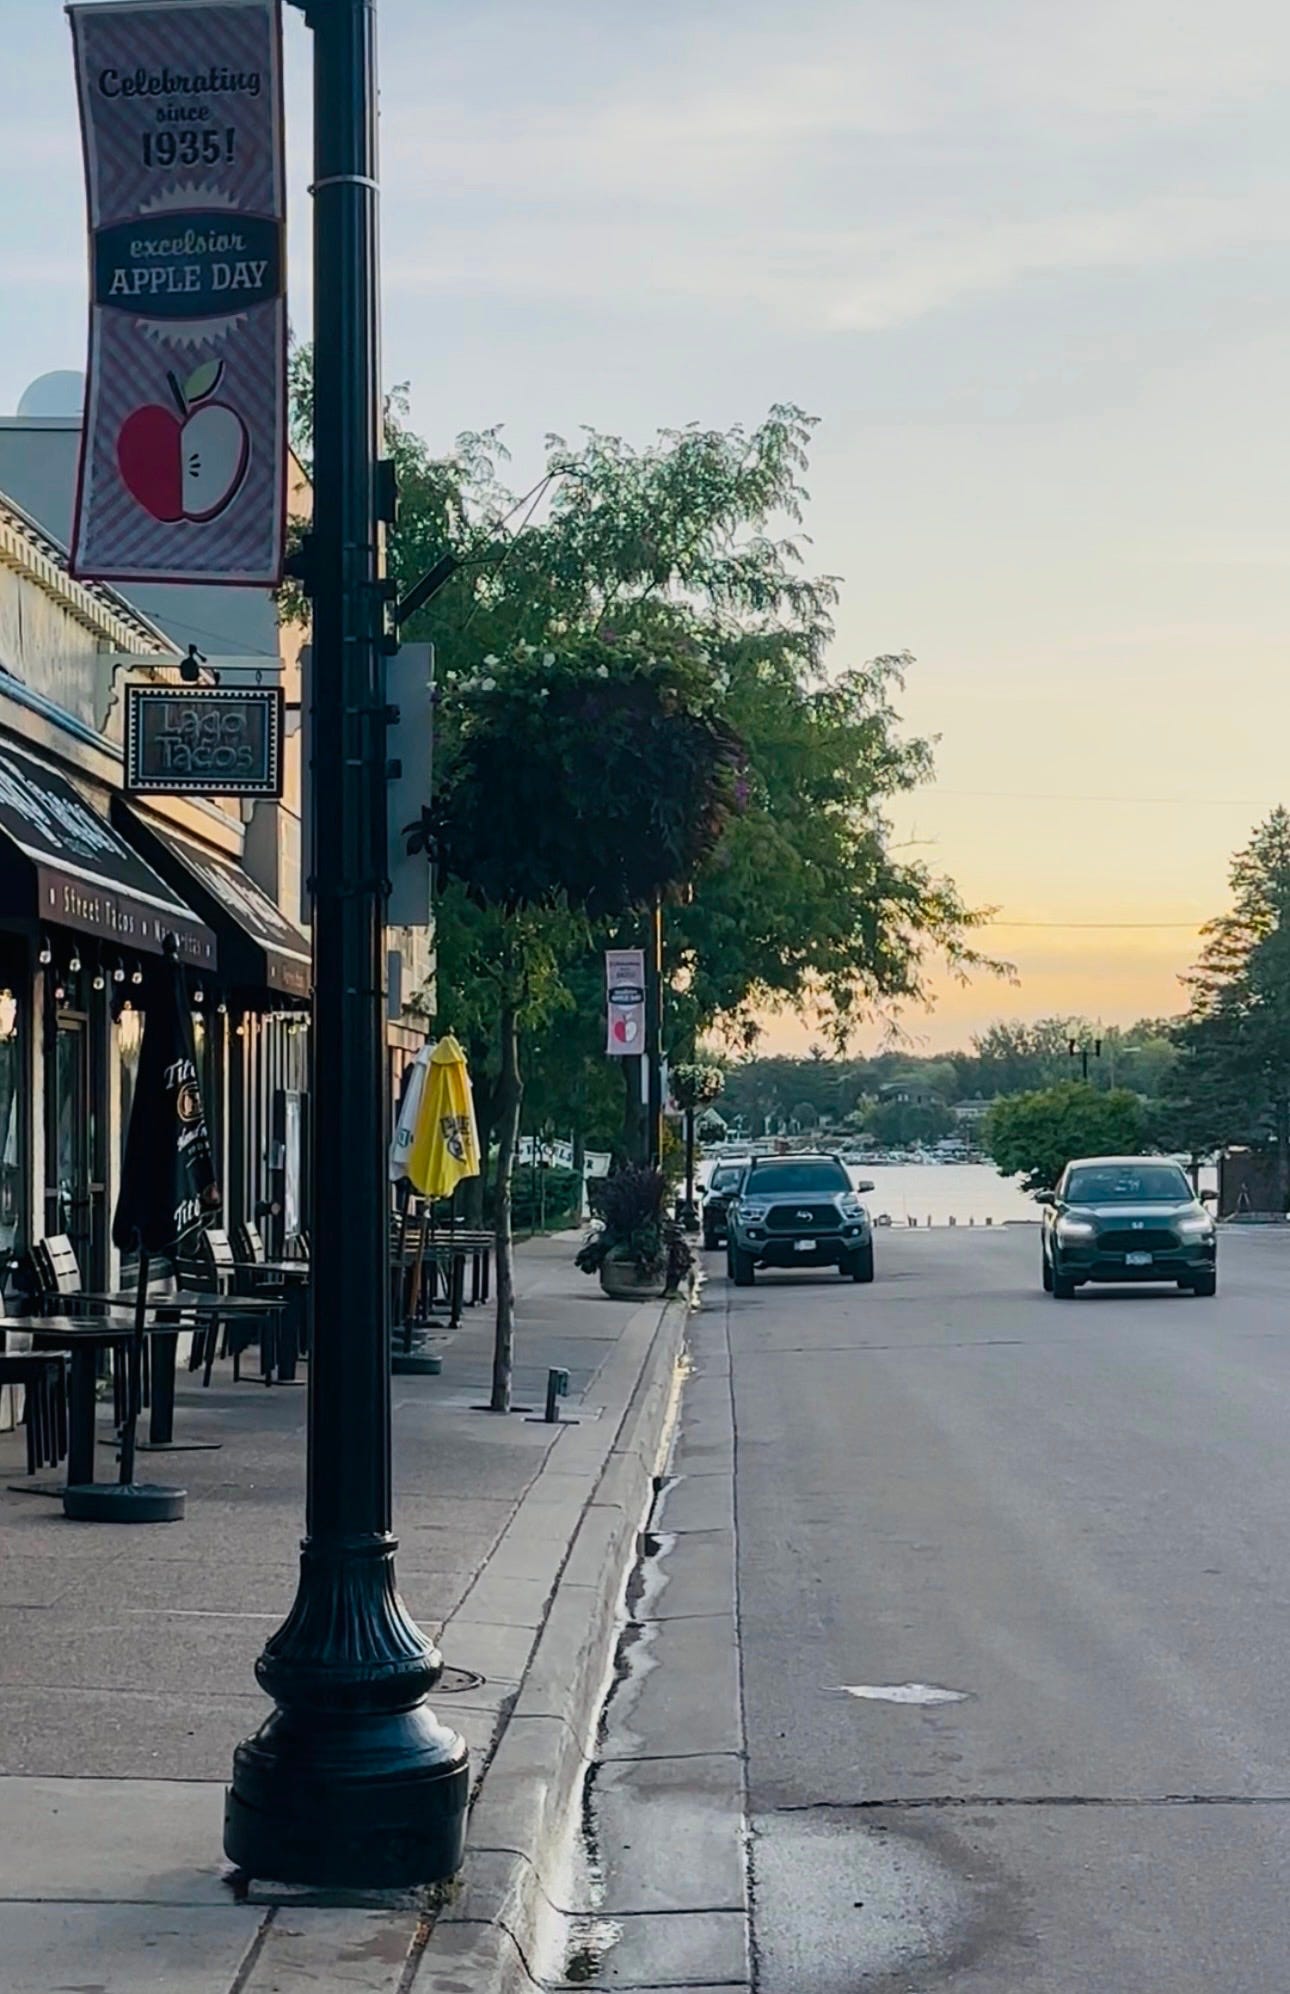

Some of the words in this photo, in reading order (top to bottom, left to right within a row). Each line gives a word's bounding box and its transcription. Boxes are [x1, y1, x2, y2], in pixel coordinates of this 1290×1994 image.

[98, 66, 261, 98] Celebrating
[156, 101, 210, 123] since
[142, 127, 236, 168] 1935!
[130, 229, 246, 259] excelsior
[109, 266, 201, 296] APPLE
[211, 260, 268, 292] DAY
[163, 703, 248, 746] Lago
[154, 735, 253, 771] Tacos
[63, 885, 100, 923] Street
[105, 901, 134, 934] Tacos
